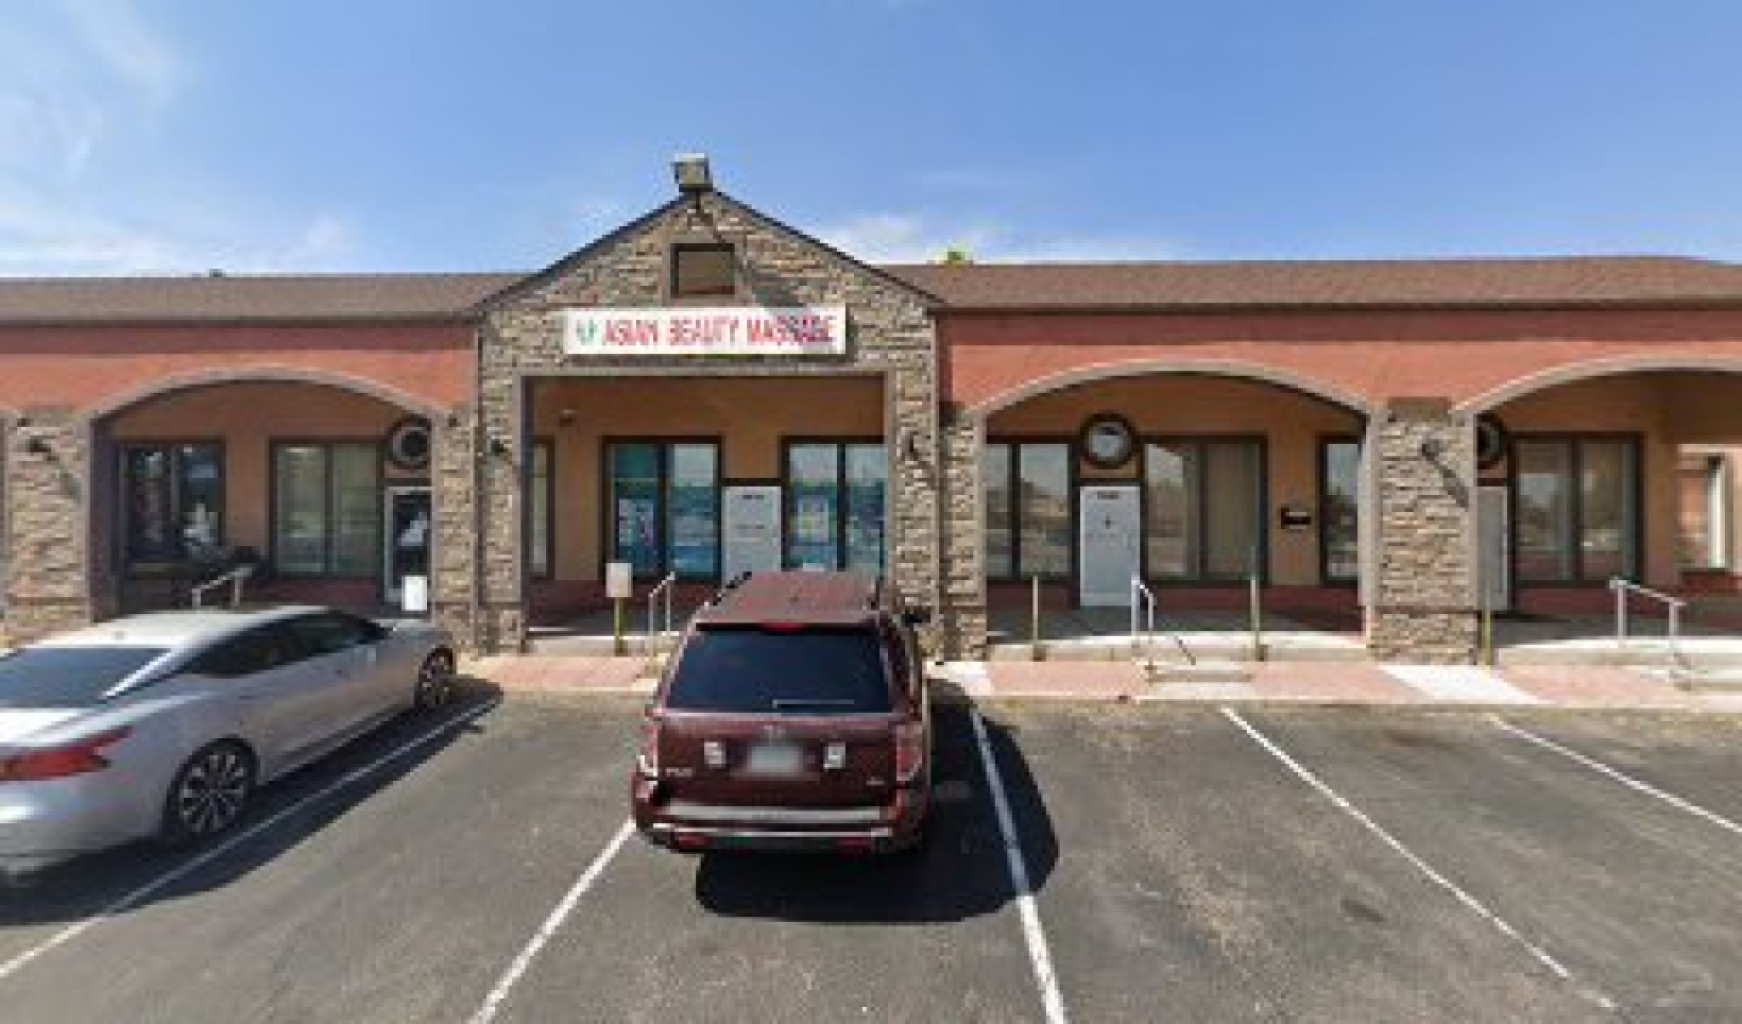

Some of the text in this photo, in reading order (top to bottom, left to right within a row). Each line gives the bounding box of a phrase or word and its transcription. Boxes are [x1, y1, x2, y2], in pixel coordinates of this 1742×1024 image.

[603, 315, 838, 346] ASIAN BEAUTY MASSAGE
